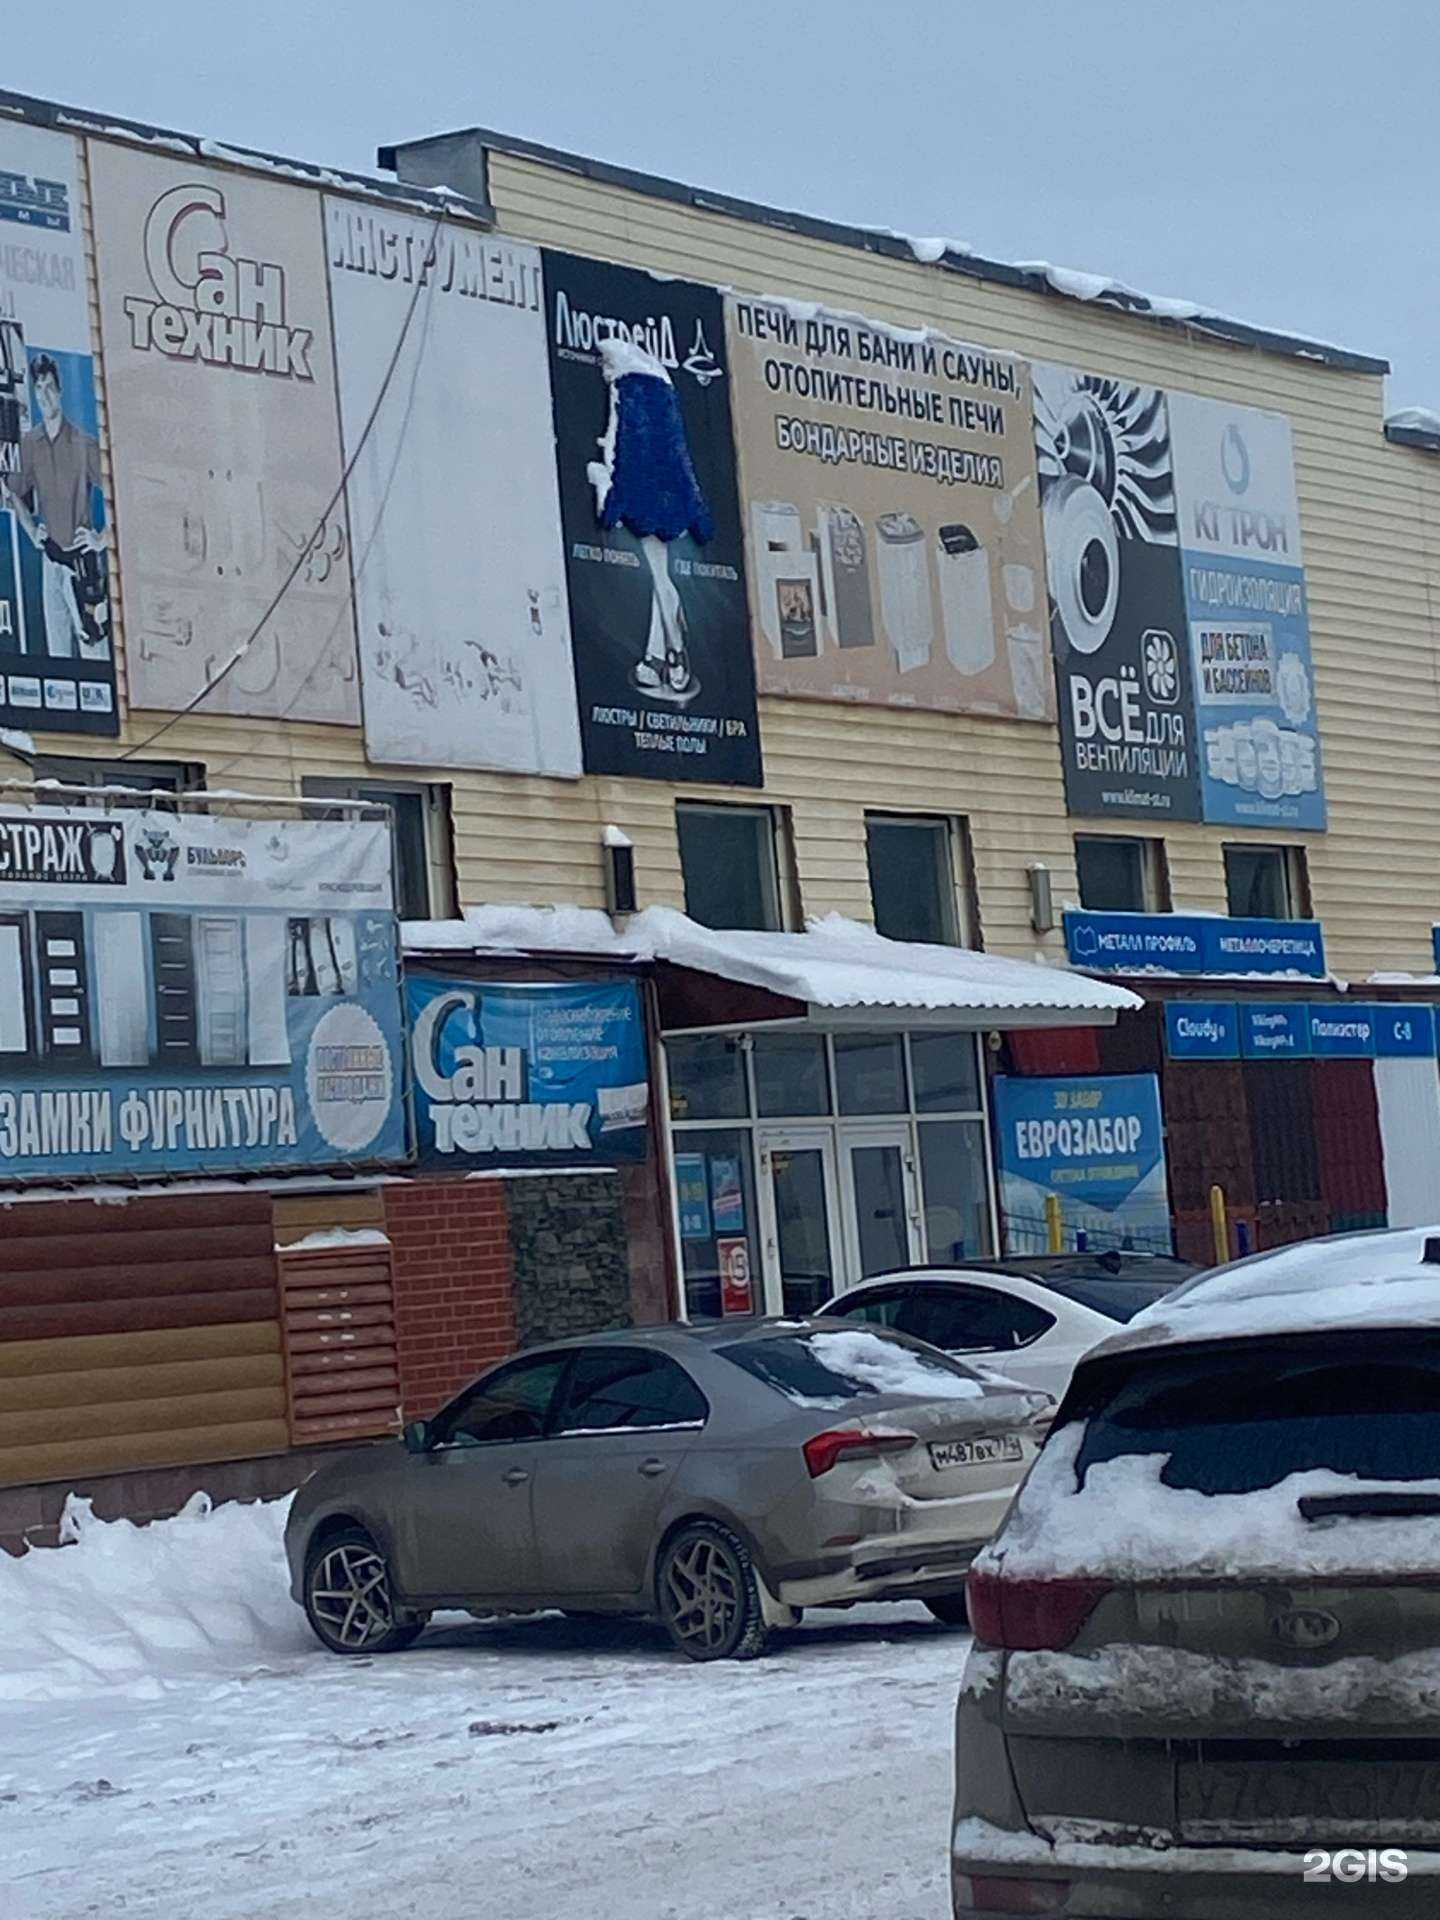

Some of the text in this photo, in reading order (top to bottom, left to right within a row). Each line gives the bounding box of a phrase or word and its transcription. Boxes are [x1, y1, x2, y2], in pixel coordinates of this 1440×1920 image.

[144, 183, 286, 325] Сан
[330, 203, 541, 312] ИНСТРУМЕНТ
[737, 303, 1021, 401] ПЕЧИ ДЛЯ БАНИ И САУНЫ,
[764, 358, 1005, 436] ОТОПИТЕЛЬНЫЕ ПЕЧИ
[774, 414, 1005, 489] БОНДАРНЫЕ ИЗДЕЛИЯ
[1190, 568, 1302, 617] ГИДРОИЗОЛЯЦИЯ
[1070, 665, 1186, 746] ВСЁ ДЛЯ
[1075, 742, 1188, 780] ВЕНТИЛЯЦИИ
[1098, 934, 1197, 952] МЕТАЛЛ ПРОФИЛЬ
[412, 990, 527, 1102] Сан
[0, 1087, 112, 1158] ЗАМКИ
[119, 1086, 298, 1152] ФУРНИТУРА
[1015, 1115, 1141, 1158] ЕВРОЗАБОР
